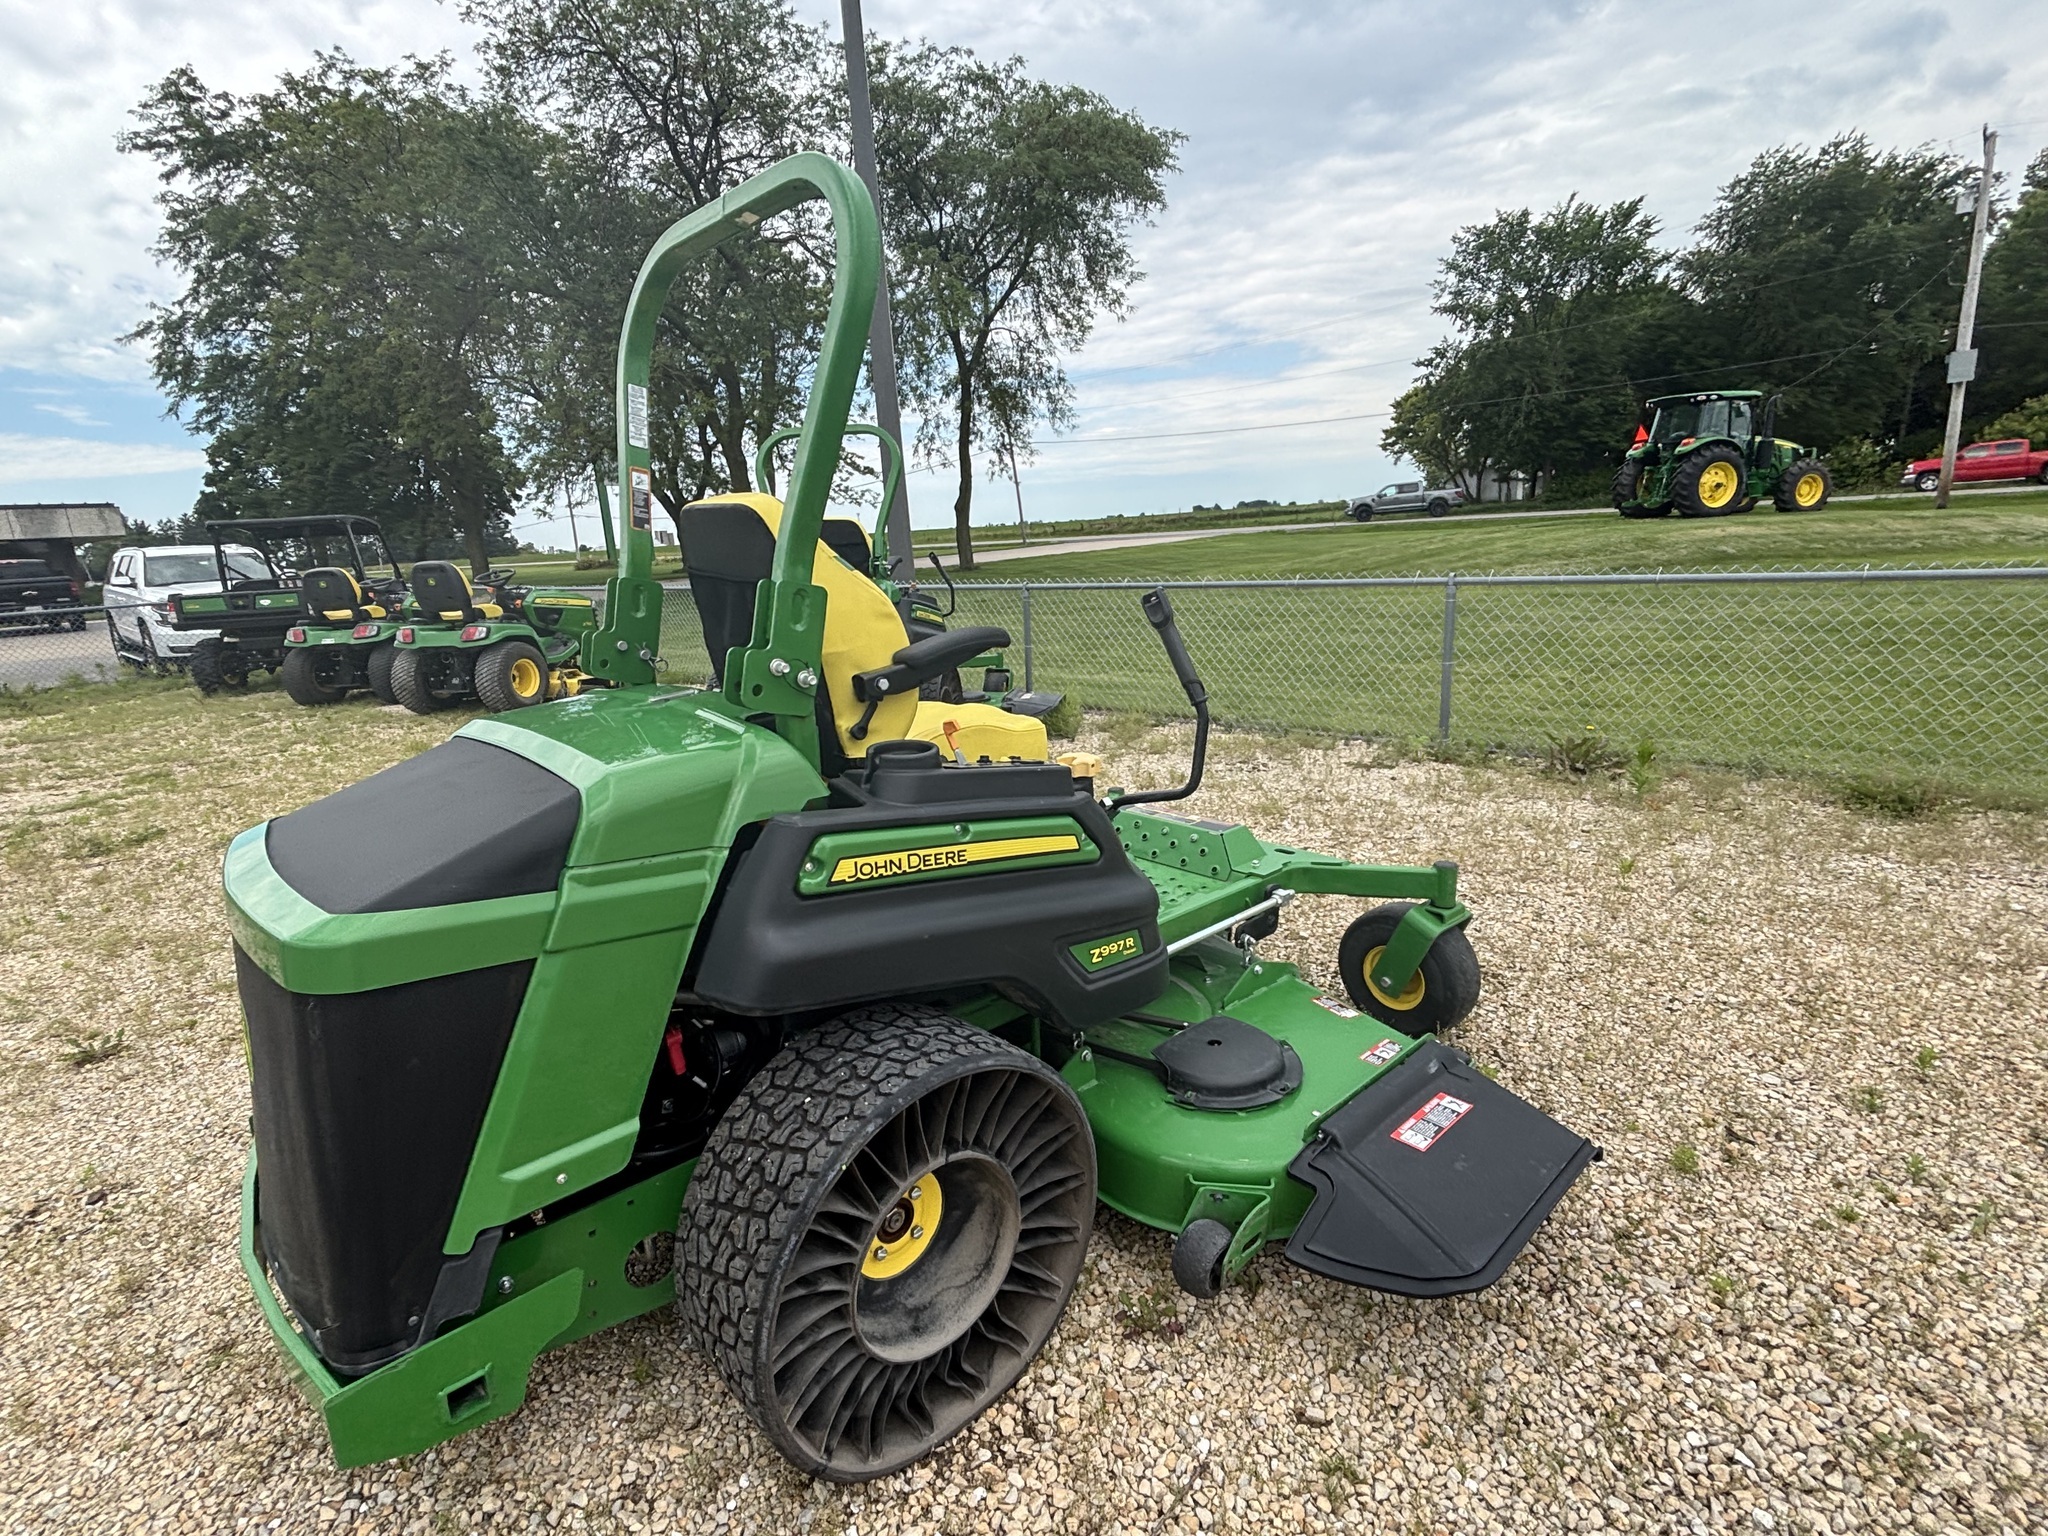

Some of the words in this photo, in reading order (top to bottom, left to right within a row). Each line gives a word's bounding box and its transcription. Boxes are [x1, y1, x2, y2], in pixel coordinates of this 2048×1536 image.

[847, 858, 902, 879] JOHN
[907, 849, 967, 870] DEERE
[1090, 937, 1135, 963] Z997R
